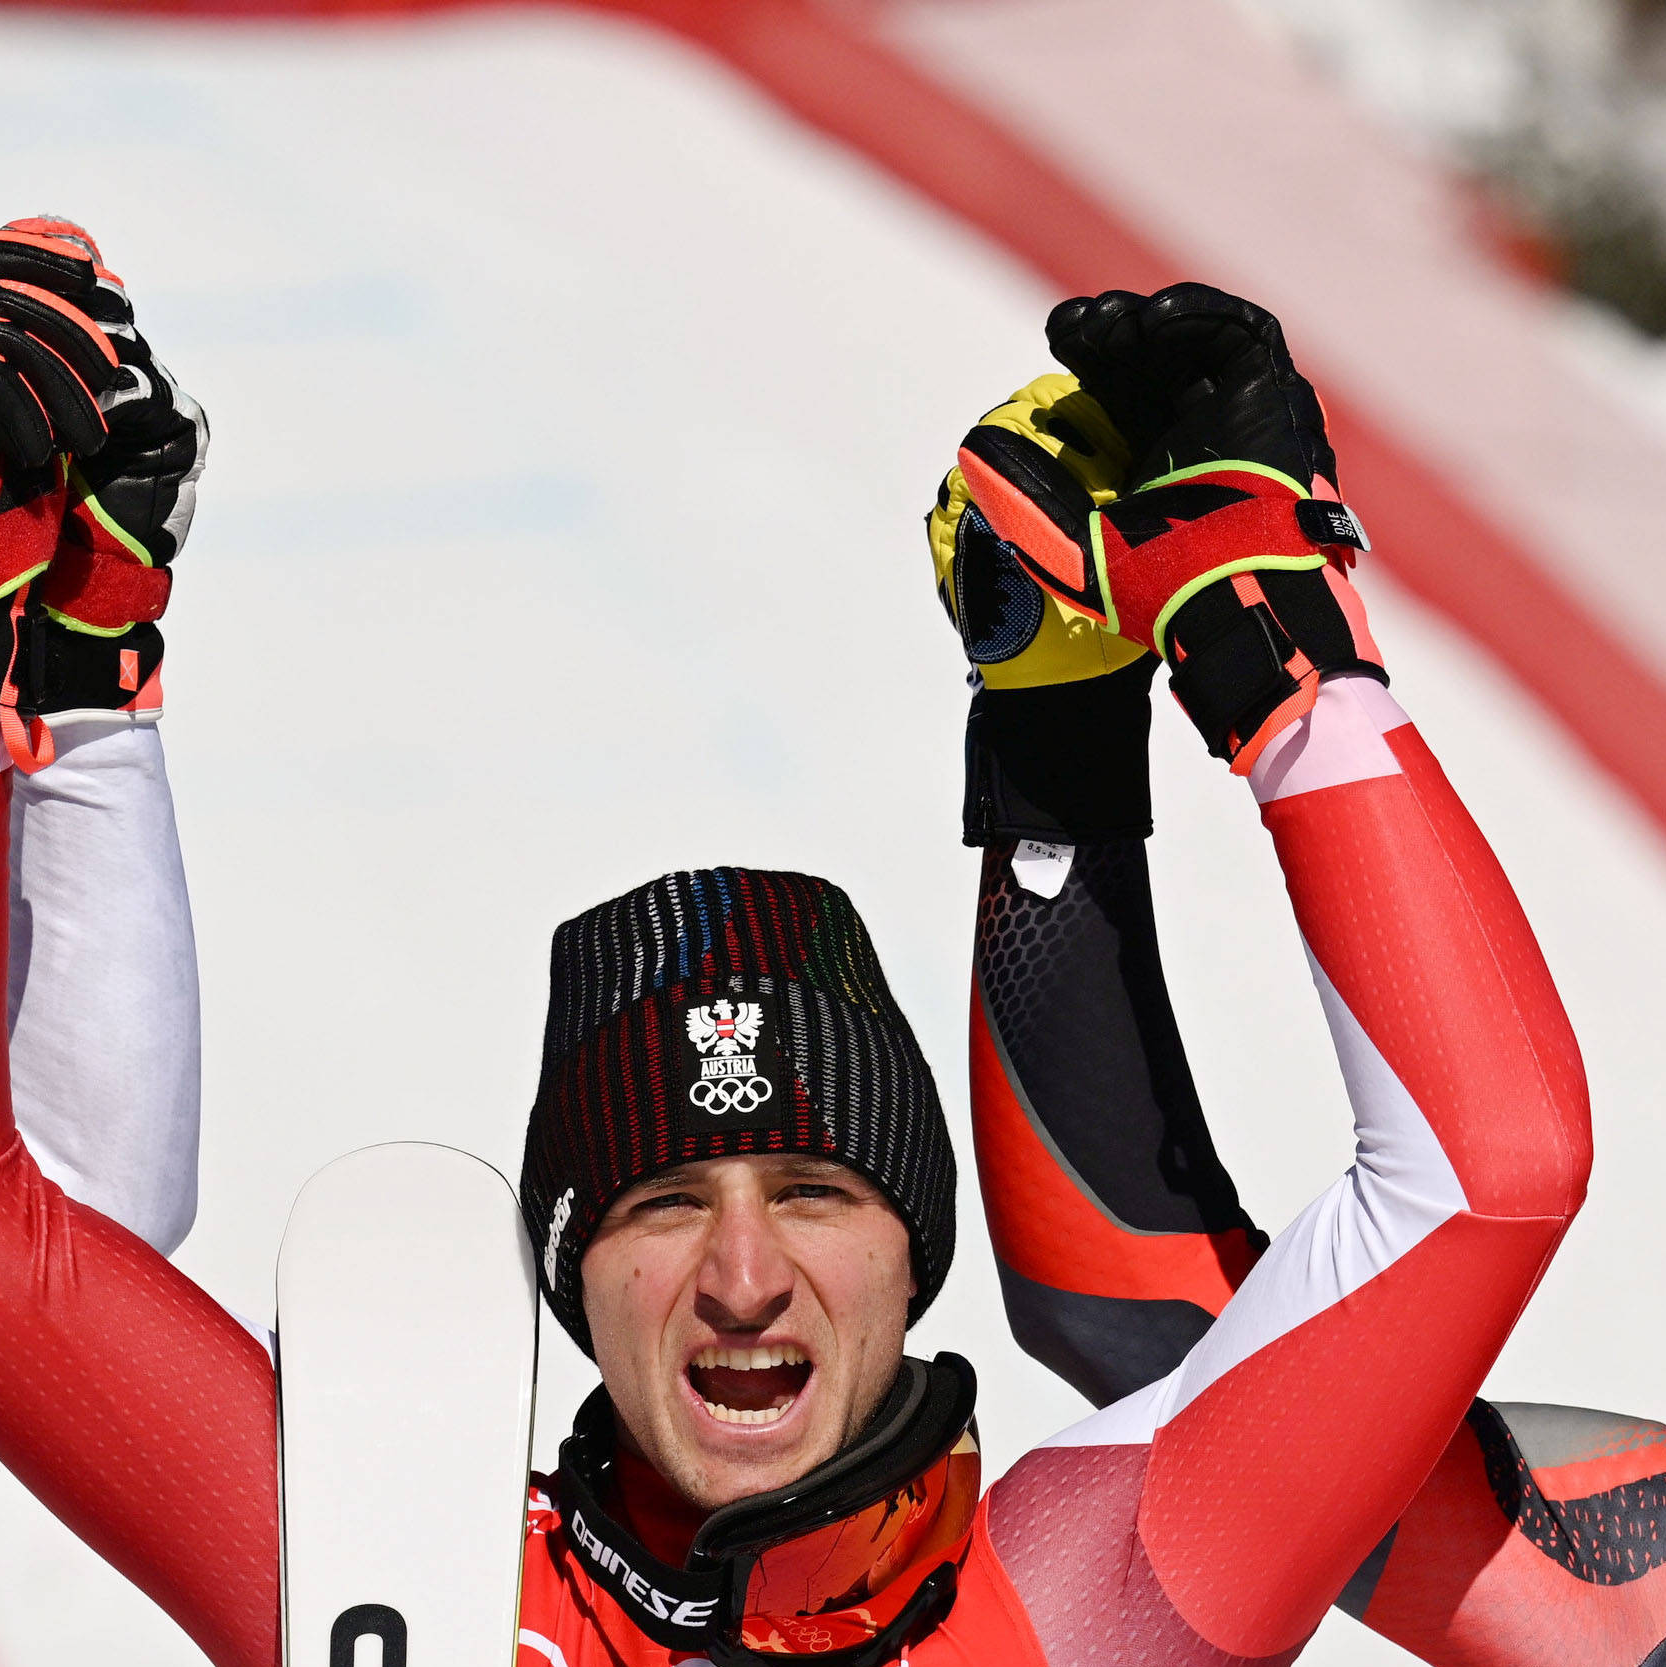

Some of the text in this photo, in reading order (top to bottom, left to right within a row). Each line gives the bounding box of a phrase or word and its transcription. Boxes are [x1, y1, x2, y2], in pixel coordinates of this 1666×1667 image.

[1328, 511, 1346, 536] ONE
[701, 1058, 757, 1077] AUSTRIA
[571, 1509, 720, 1628] DAINESE
